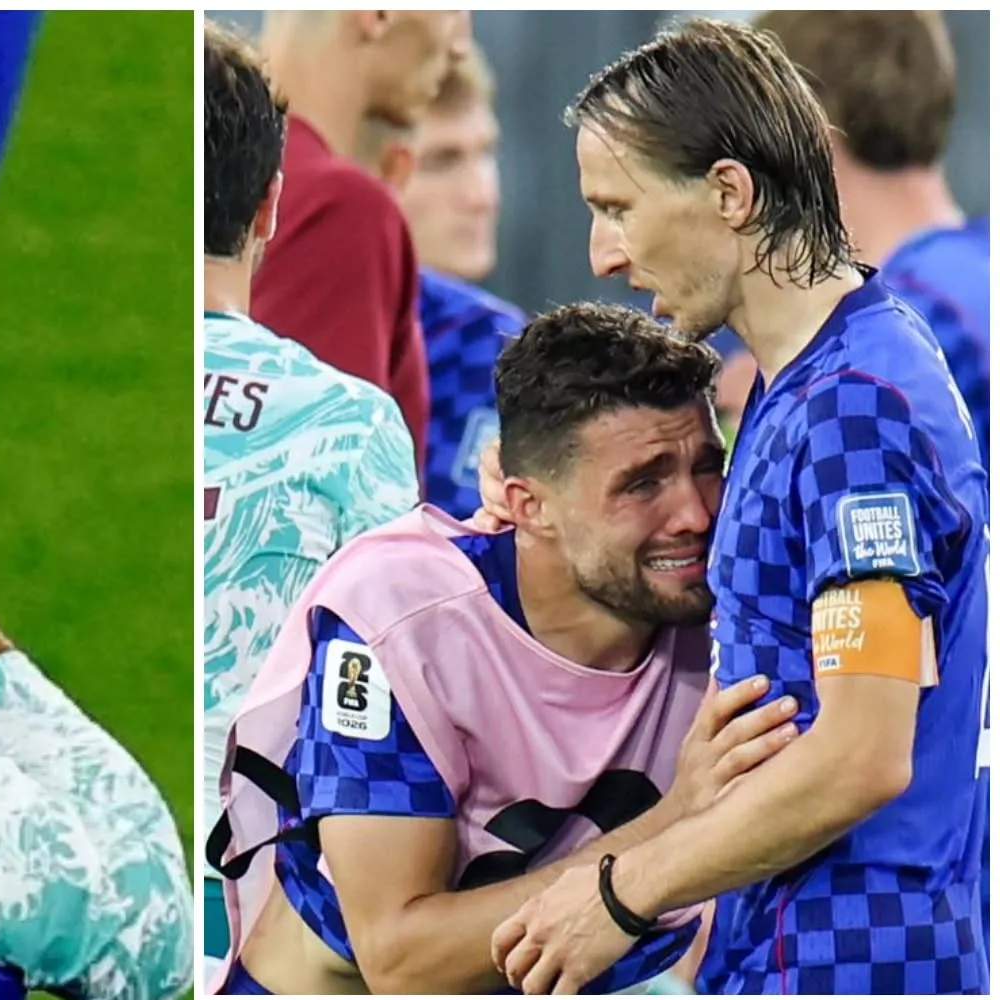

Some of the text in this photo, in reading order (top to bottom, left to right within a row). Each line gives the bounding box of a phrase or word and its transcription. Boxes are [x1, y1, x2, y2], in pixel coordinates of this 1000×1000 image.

[851, 507, 900, 522] FOOTBALL
[853, 520, 902, 542] UNITES
[854, 543, 875, 559] the
[820, 630, 866, 653] World
